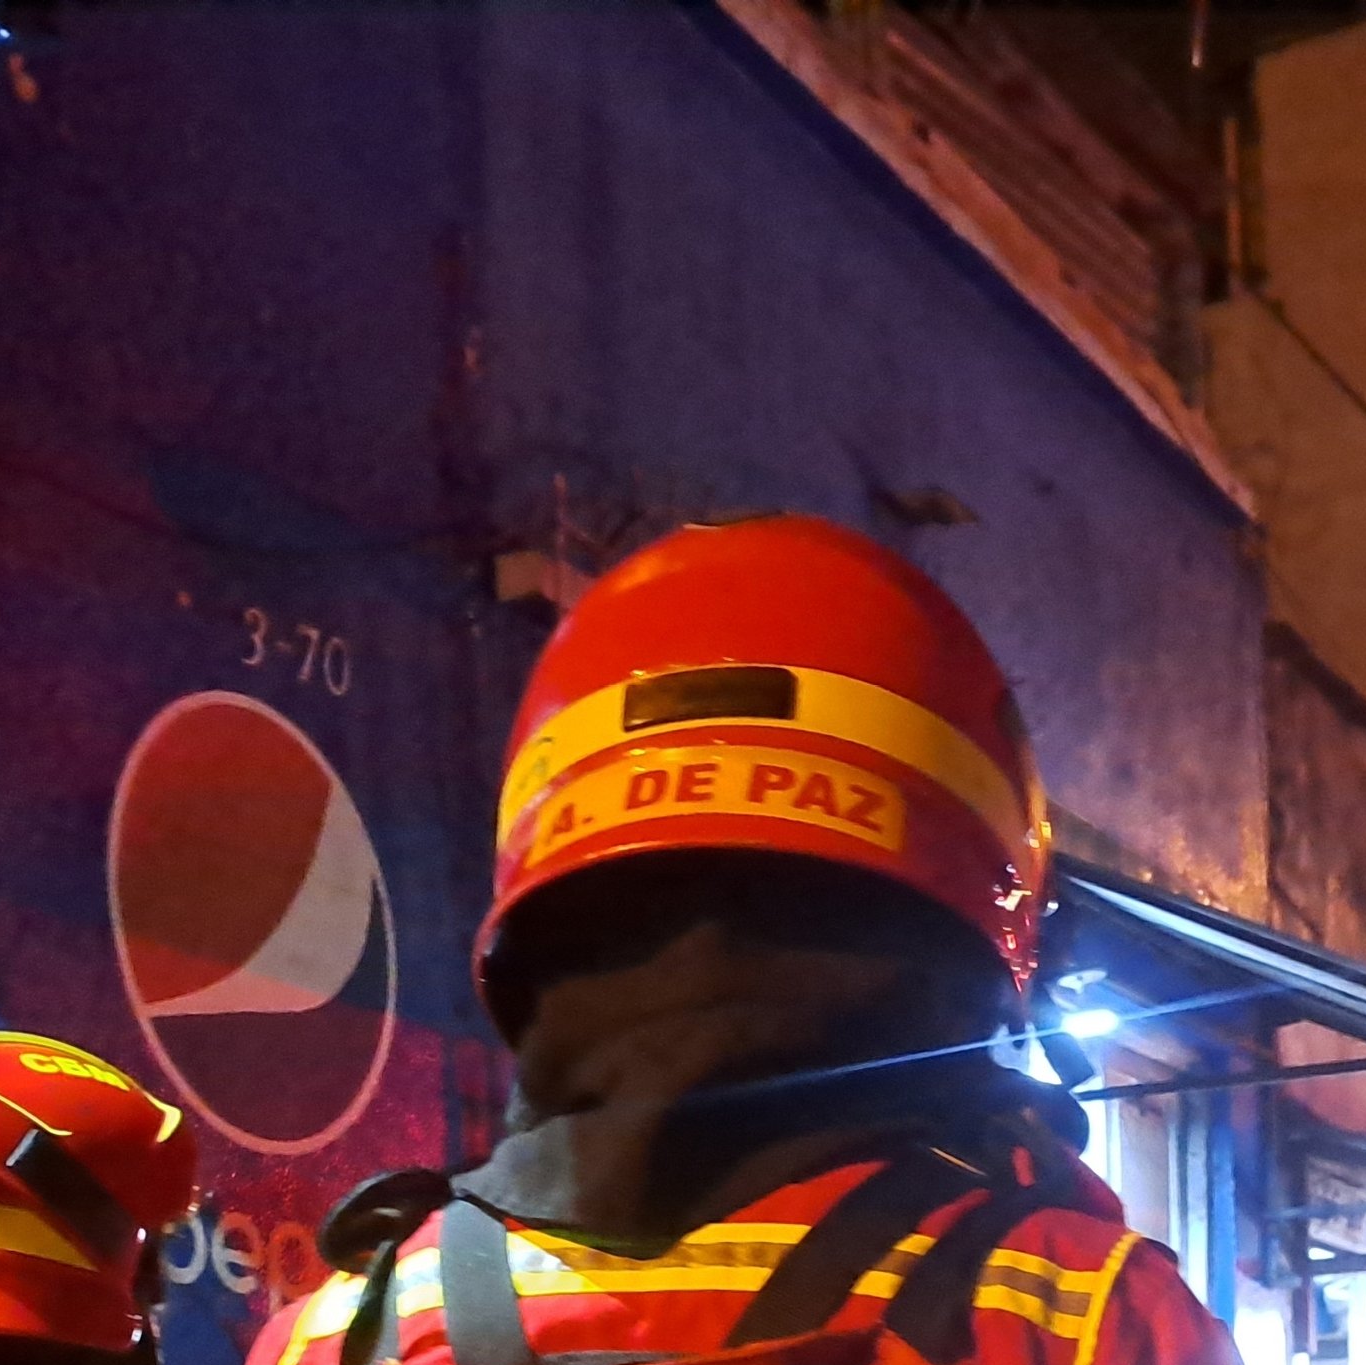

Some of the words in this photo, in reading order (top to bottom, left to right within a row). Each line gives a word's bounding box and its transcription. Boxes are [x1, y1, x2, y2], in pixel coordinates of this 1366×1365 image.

[240, 606, 351, 697] 3-70
[624, 762, 720, 811] DE
[745, 764, 886, 834] PAZ
